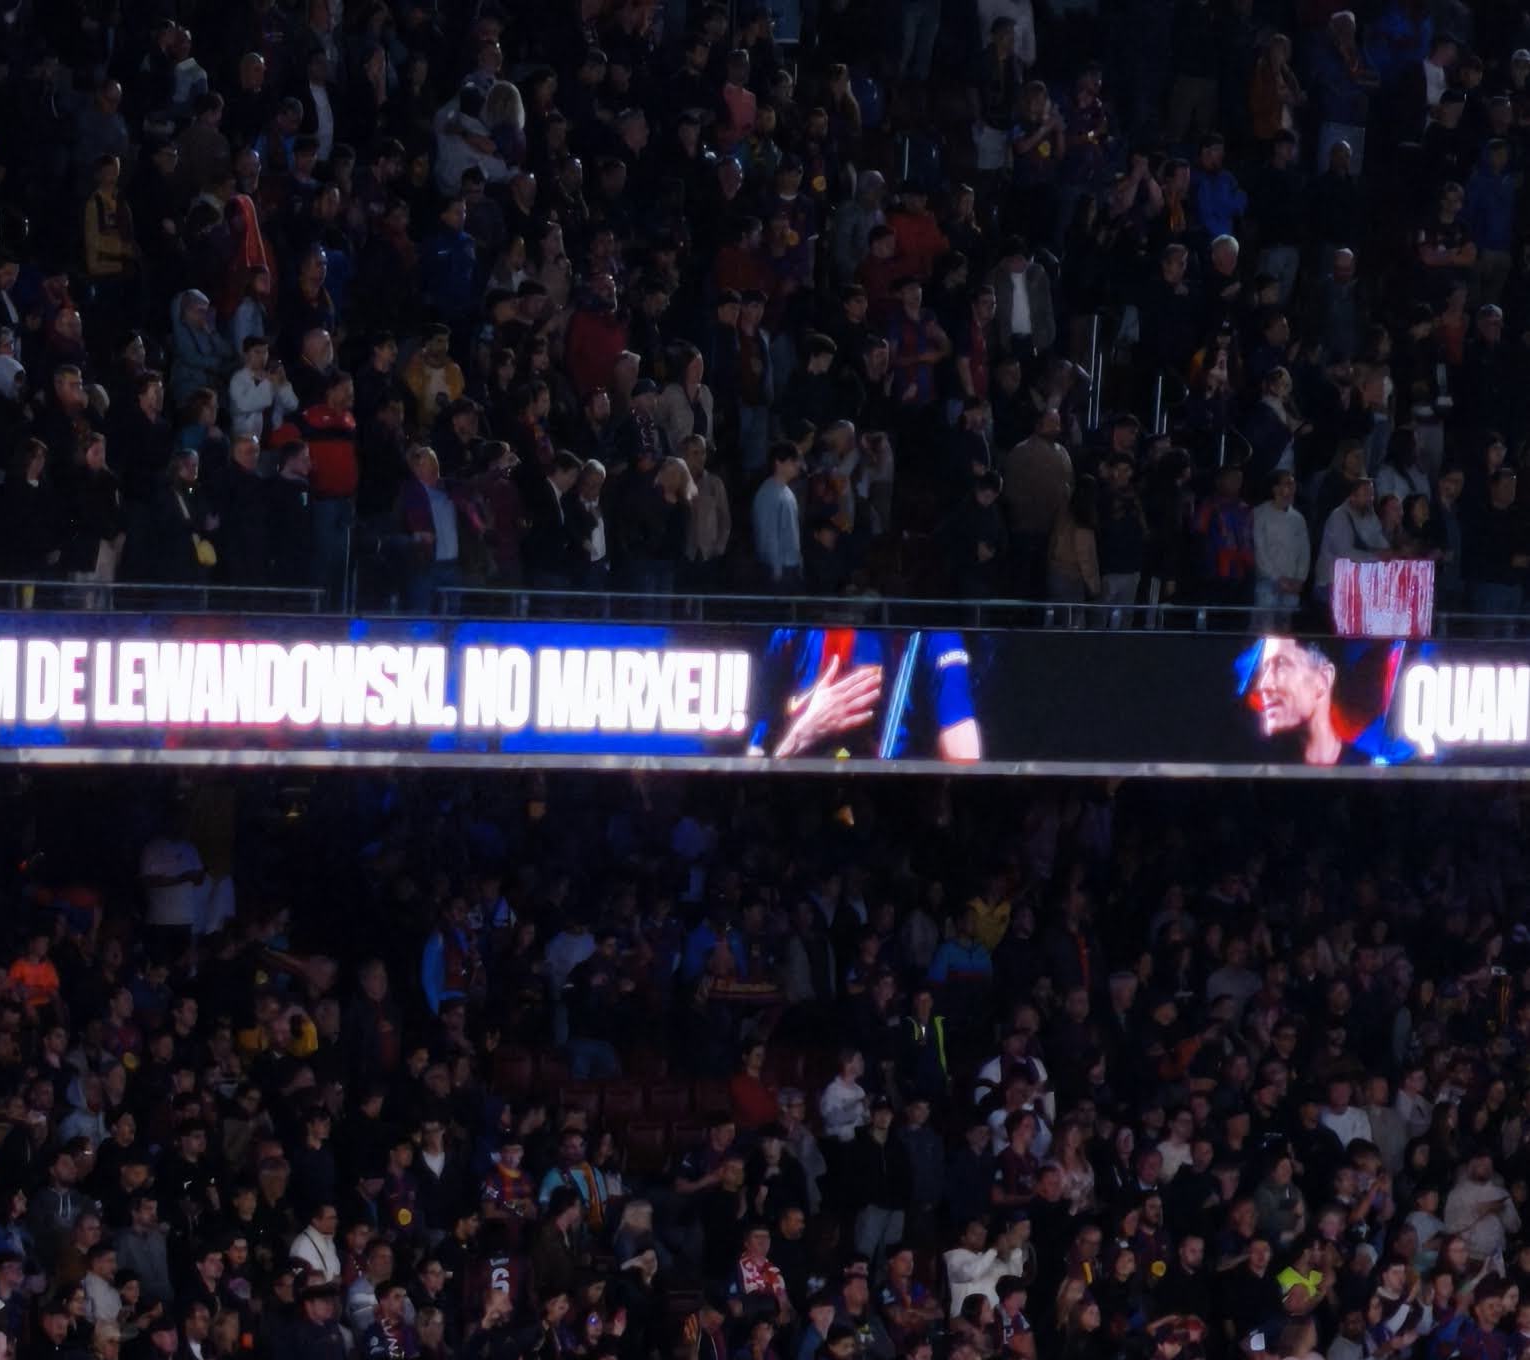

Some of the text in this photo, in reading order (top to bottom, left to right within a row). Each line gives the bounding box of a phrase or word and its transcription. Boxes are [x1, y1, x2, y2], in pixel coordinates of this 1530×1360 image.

[24, 640, 86, 722] DE
[95, 641, 458, 728] LEWANDOWSKI.
[464, 648, 531, 727] NO
[538, 649, 750, 731] MARXEU!
[1404, 664, 1530, 755] QUAN
